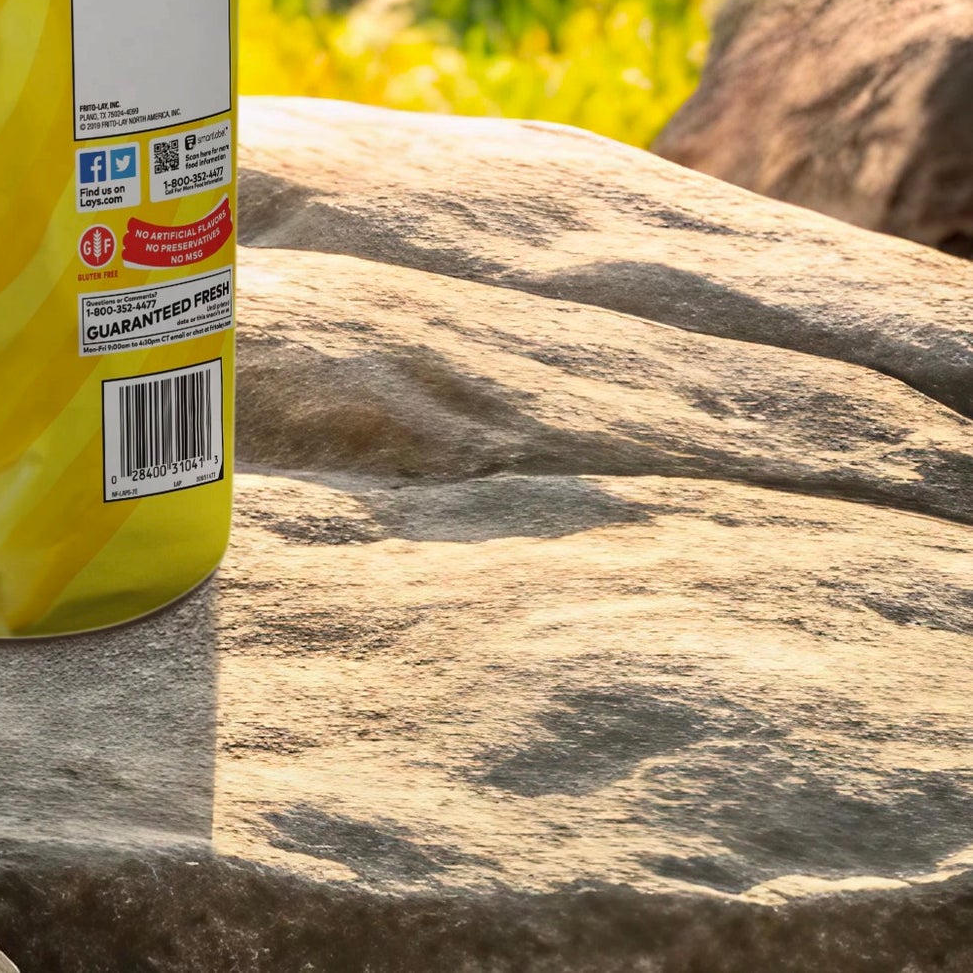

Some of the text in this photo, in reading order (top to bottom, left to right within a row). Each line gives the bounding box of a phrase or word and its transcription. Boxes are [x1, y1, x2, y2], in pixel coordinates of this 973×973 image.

[101, 118, 129, 129] FRITO-LAY
[128, 114, 147, 124] NORTH
[171, 108, 182, 116] INC.
[185, 150, 212, 162] Scan here
[185, 153, 227, 170] food information
[163, 166, 224, 189] 1-800-352-4477
[80, 184, 126, 198] Find us on
[80, 194, 123, 208] Lays.com
[135, 209, 227, 241] NO ARTIFICIAL FLAVORS
[83, 238, 111, 256] G F
[145, 227, 221, 253] NO PRESERVATIVES
[171, 249, 203, 264] NO MSG
[78, 270, 118, 282] GLUTEN FREE
[86, 291, 158, 307] Questions Comments?
[86, 299, 157, 318] 1-800-352-4477
[87, 281, 229, 340] GUARANTEED FRESH
[83, 345, 107, 353] Mon-Fri
[170, 331, 186, 341] email
[111, 455, 219, 485] 0 28400 31041 3
